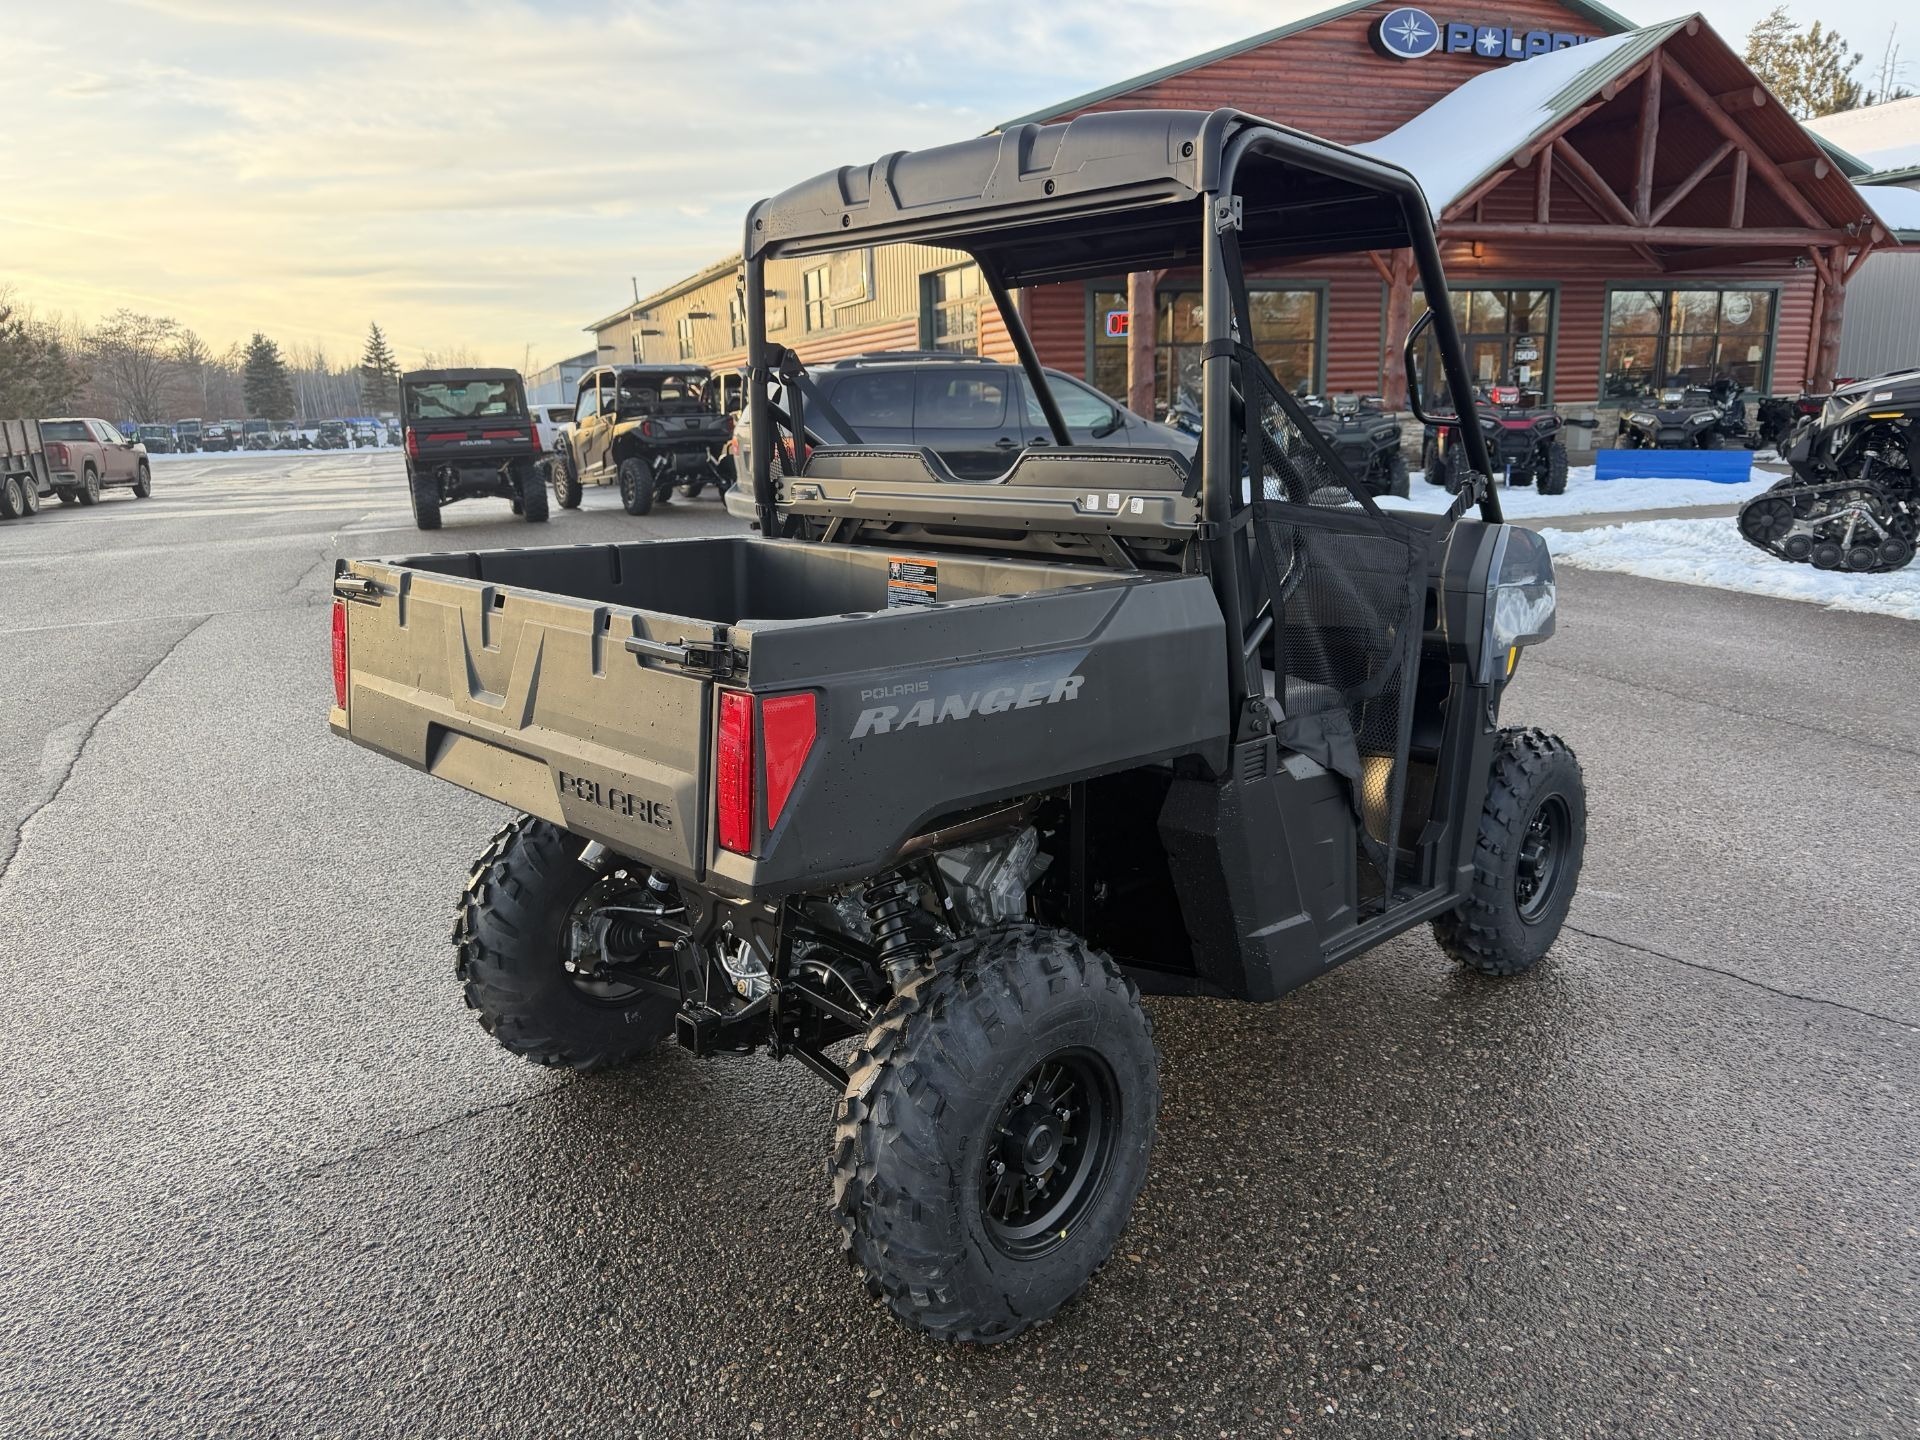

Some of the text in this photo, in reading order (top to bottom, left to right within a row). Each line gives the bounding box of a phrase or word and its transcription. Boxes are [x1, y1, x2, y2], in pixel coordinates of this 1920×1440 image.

[1445, 23, 1600, 59] POLAR
[1109, 314, 1128, 334] OP
[849, 675, 1085, 739] RANGER
[860, 680, 929, 702] POLARIS
[558, 770, 673, 831] POLARIS
